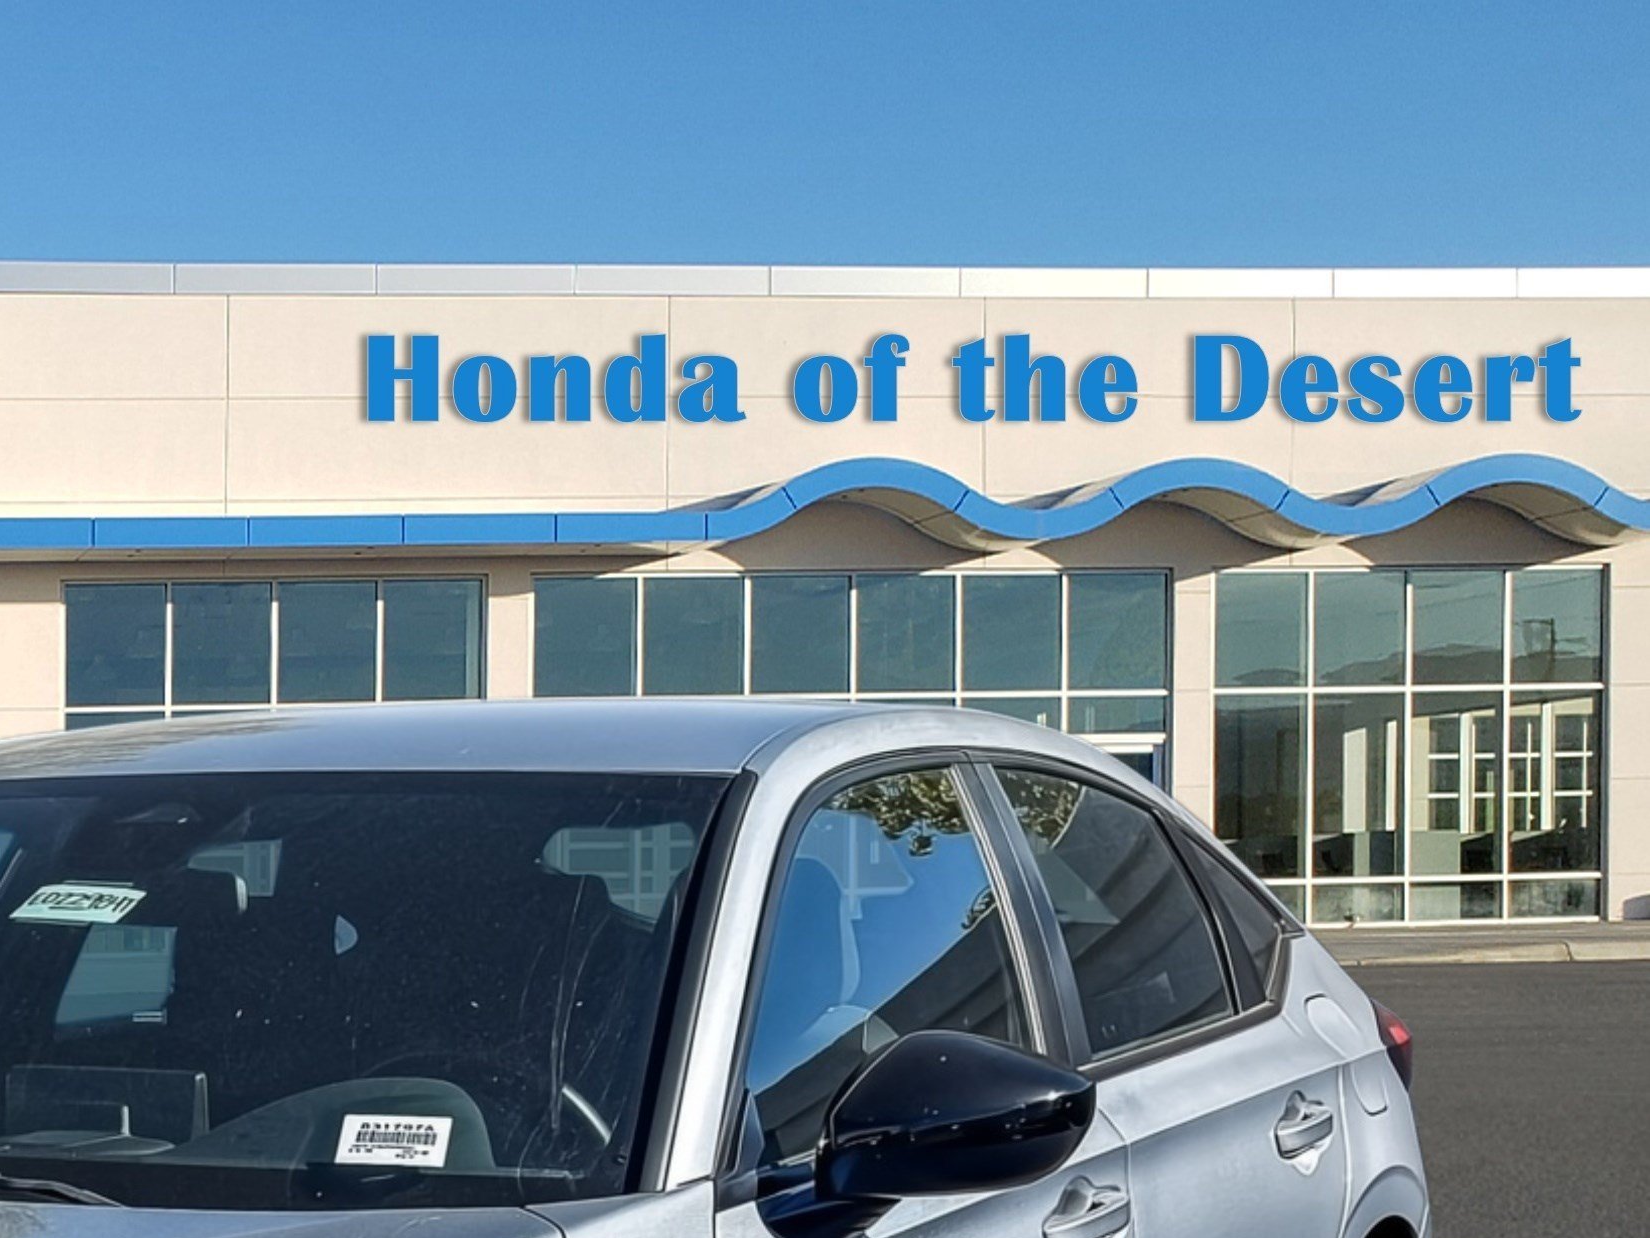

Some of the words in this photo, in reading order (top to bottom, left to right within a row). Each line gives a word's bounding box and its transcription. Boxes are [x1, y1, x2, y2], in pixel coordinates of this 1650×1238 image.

[366, 333, 746, 423] Honda
[793, 332, 910, 423] of
[952, 333, 1139, 423] the
[1193, 333, 1582, 423] Desert
